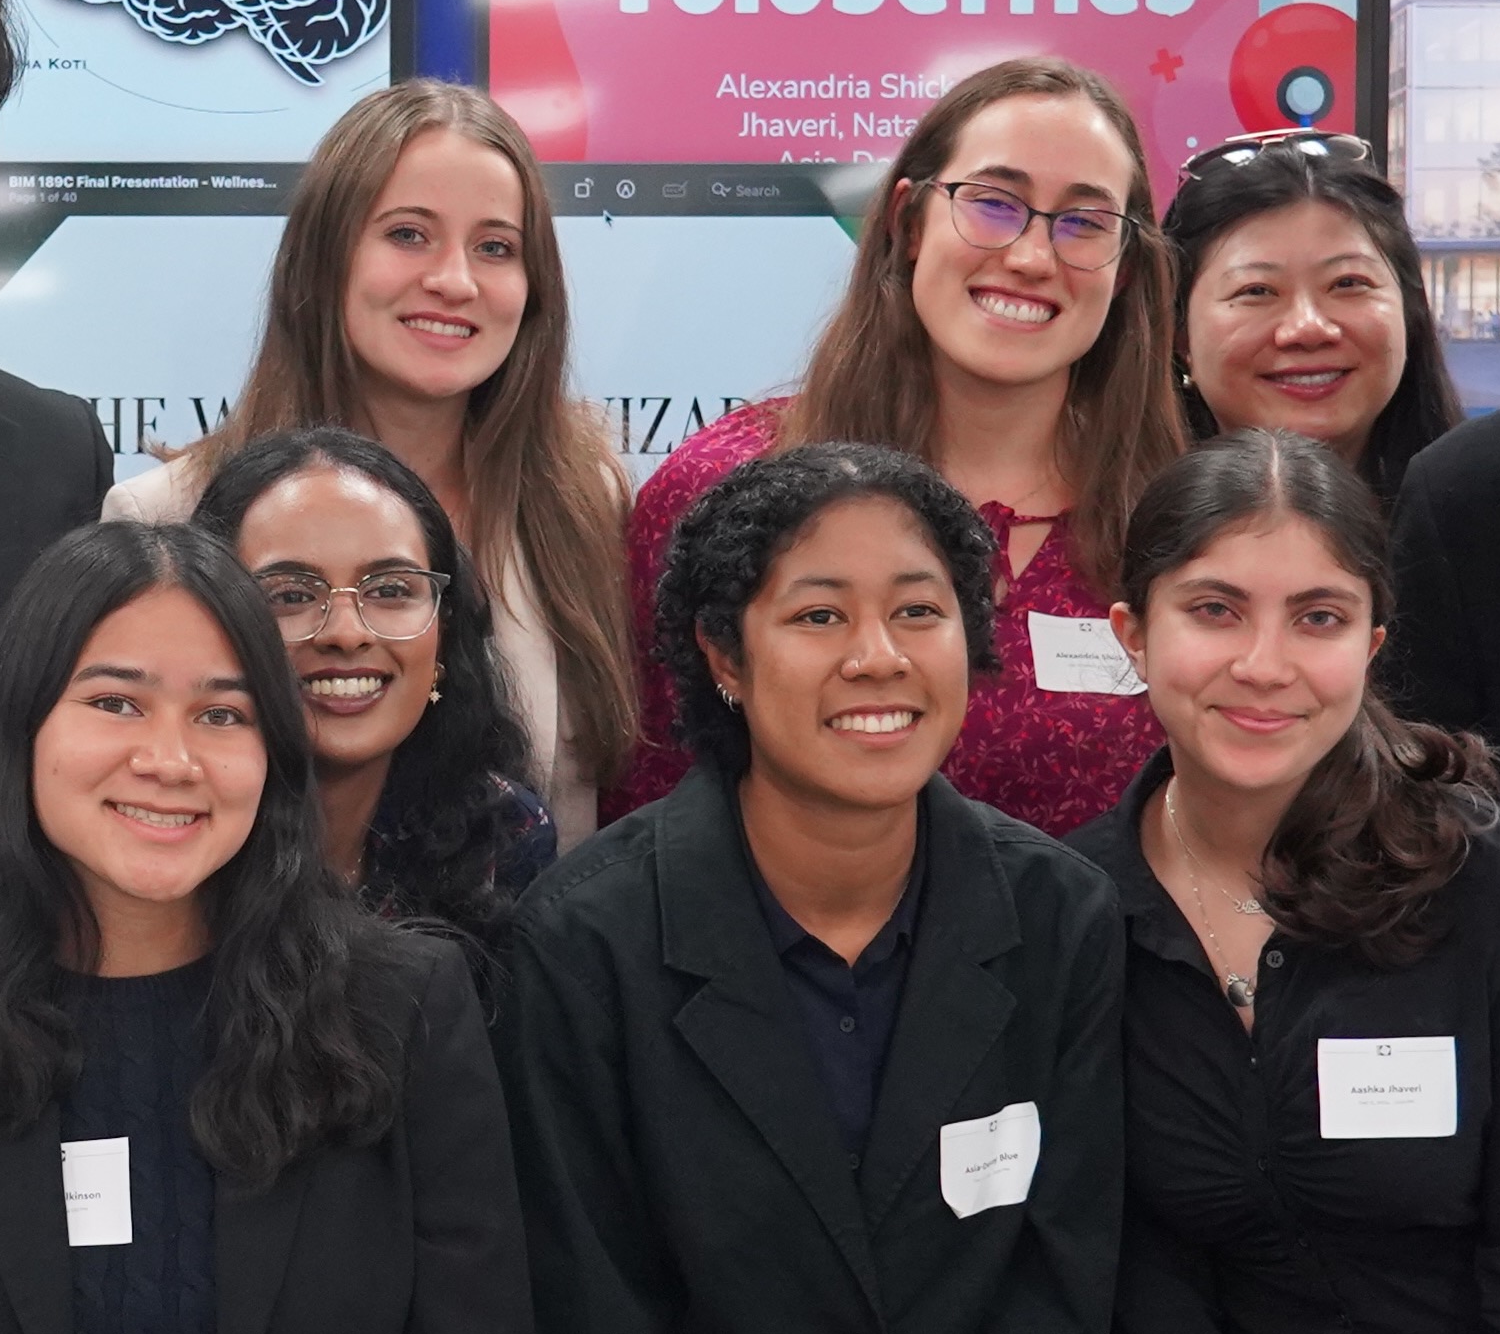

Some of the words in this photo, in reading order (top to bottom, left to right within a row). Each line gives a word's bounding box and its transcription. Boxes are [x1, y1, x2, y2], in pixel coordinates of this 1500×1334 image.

[48, 58, 87, 70] KOTI
[716, 73, 870, 99] Alexandria
[739, 112, 844, 141] Jhaveri,
[9, 175, 35, 189] BIM
[38, 175, 74, 189] 189C
[76, 175, 110, 189] Final
[112, 175, 199, 189] Presentation
[735, 184, 781, 198] Search
[9, 192, 37, 205] Page
[48, 192, 60, 202] of
[61, 192, 78, 202] 40
[88, 397, 167, 455] HE
[1388, 1083, 1422, 1093] Jhaveri
[65, 1191, 101, 1201] lkinson
